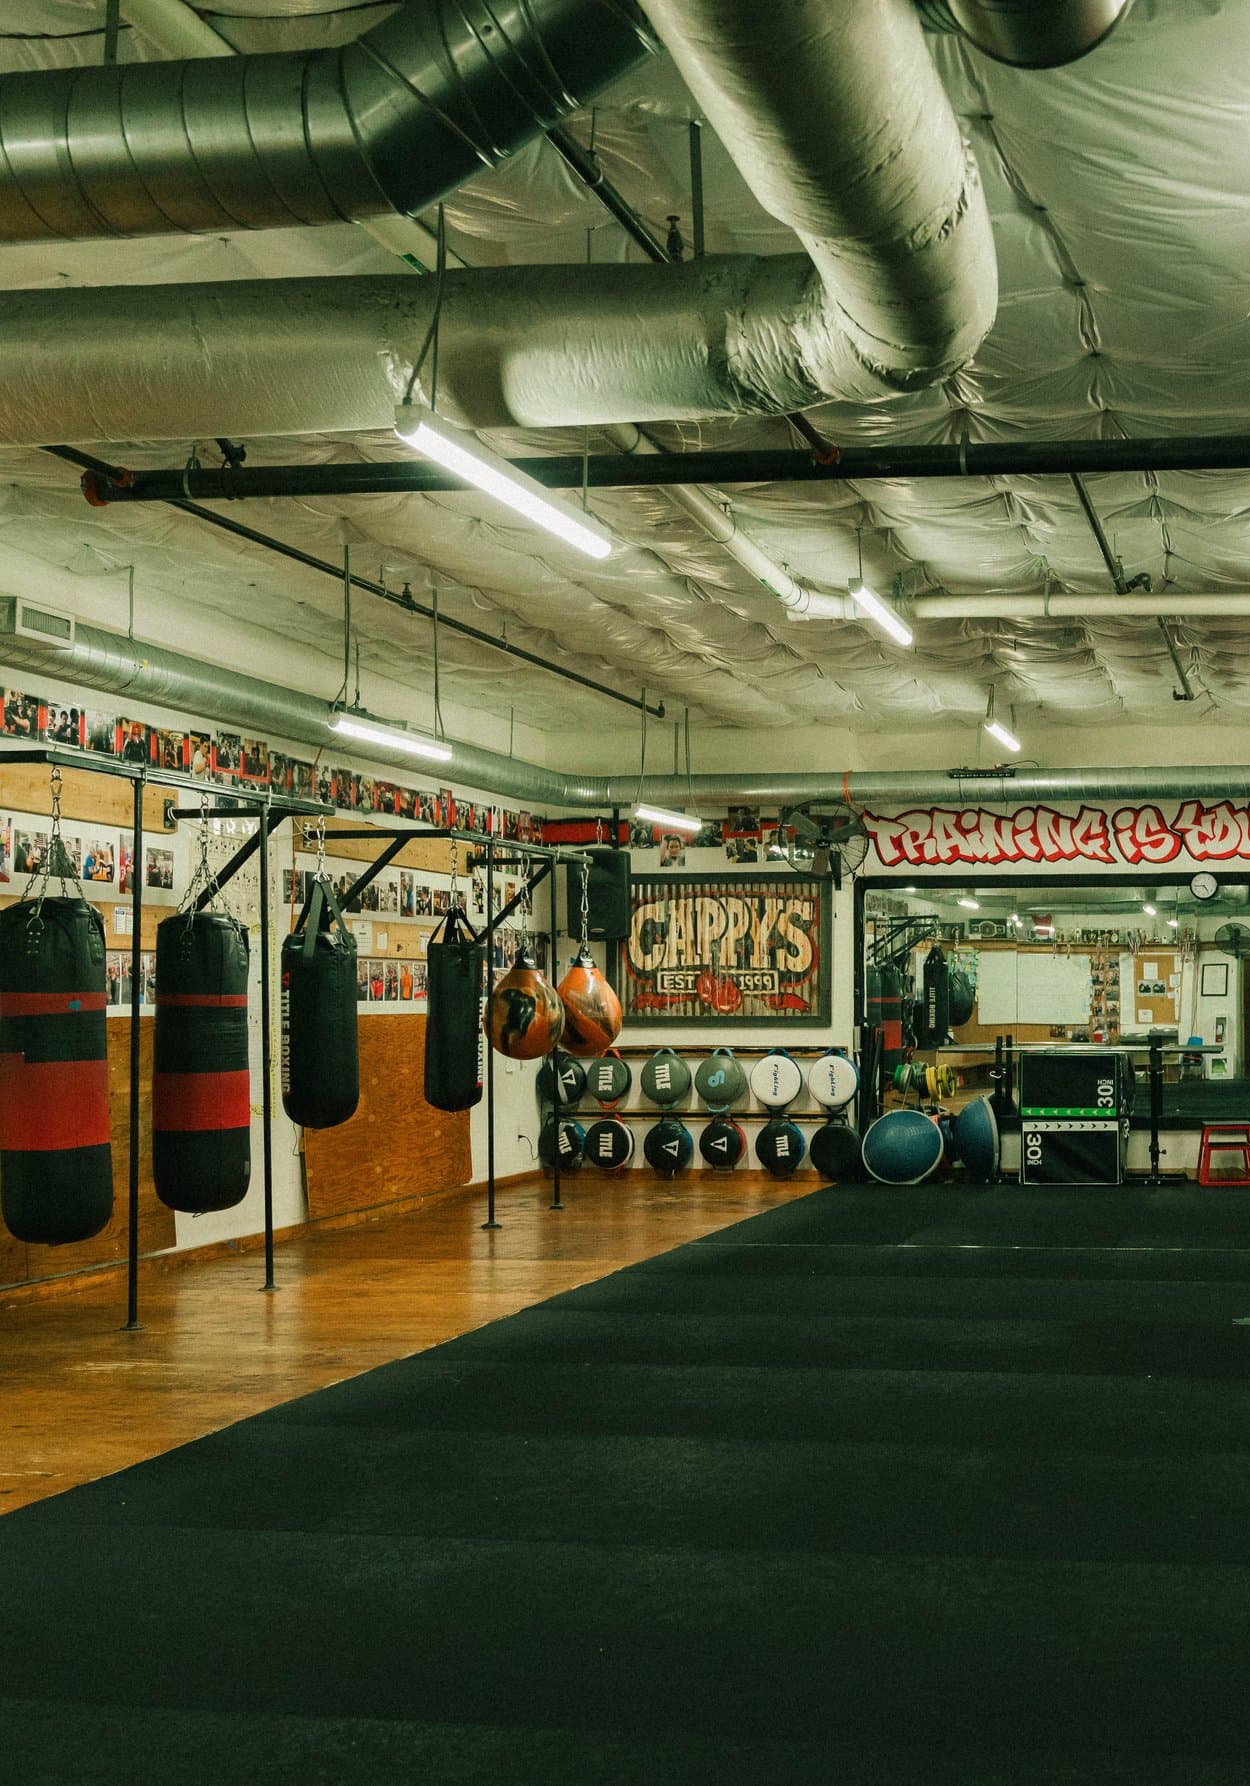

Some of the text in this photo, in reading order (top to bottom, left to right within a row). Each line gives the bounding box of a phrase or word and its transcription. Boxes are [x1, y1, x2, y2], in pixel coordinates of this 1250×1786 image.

[738, 974, 772, 990] 1999
[281, 989, 290, 1030] TITLE
[599, 1065, 613, 1091] TITLE
[655, 1063, 672, 1090] TITLE
[1097, 1085, 1114, 1108] 30
[600, 1132, 613, 1158] TITLE
[775, 1134, 791, 1157] TITLE
[1026, 1133, 1042, 1159] 30
